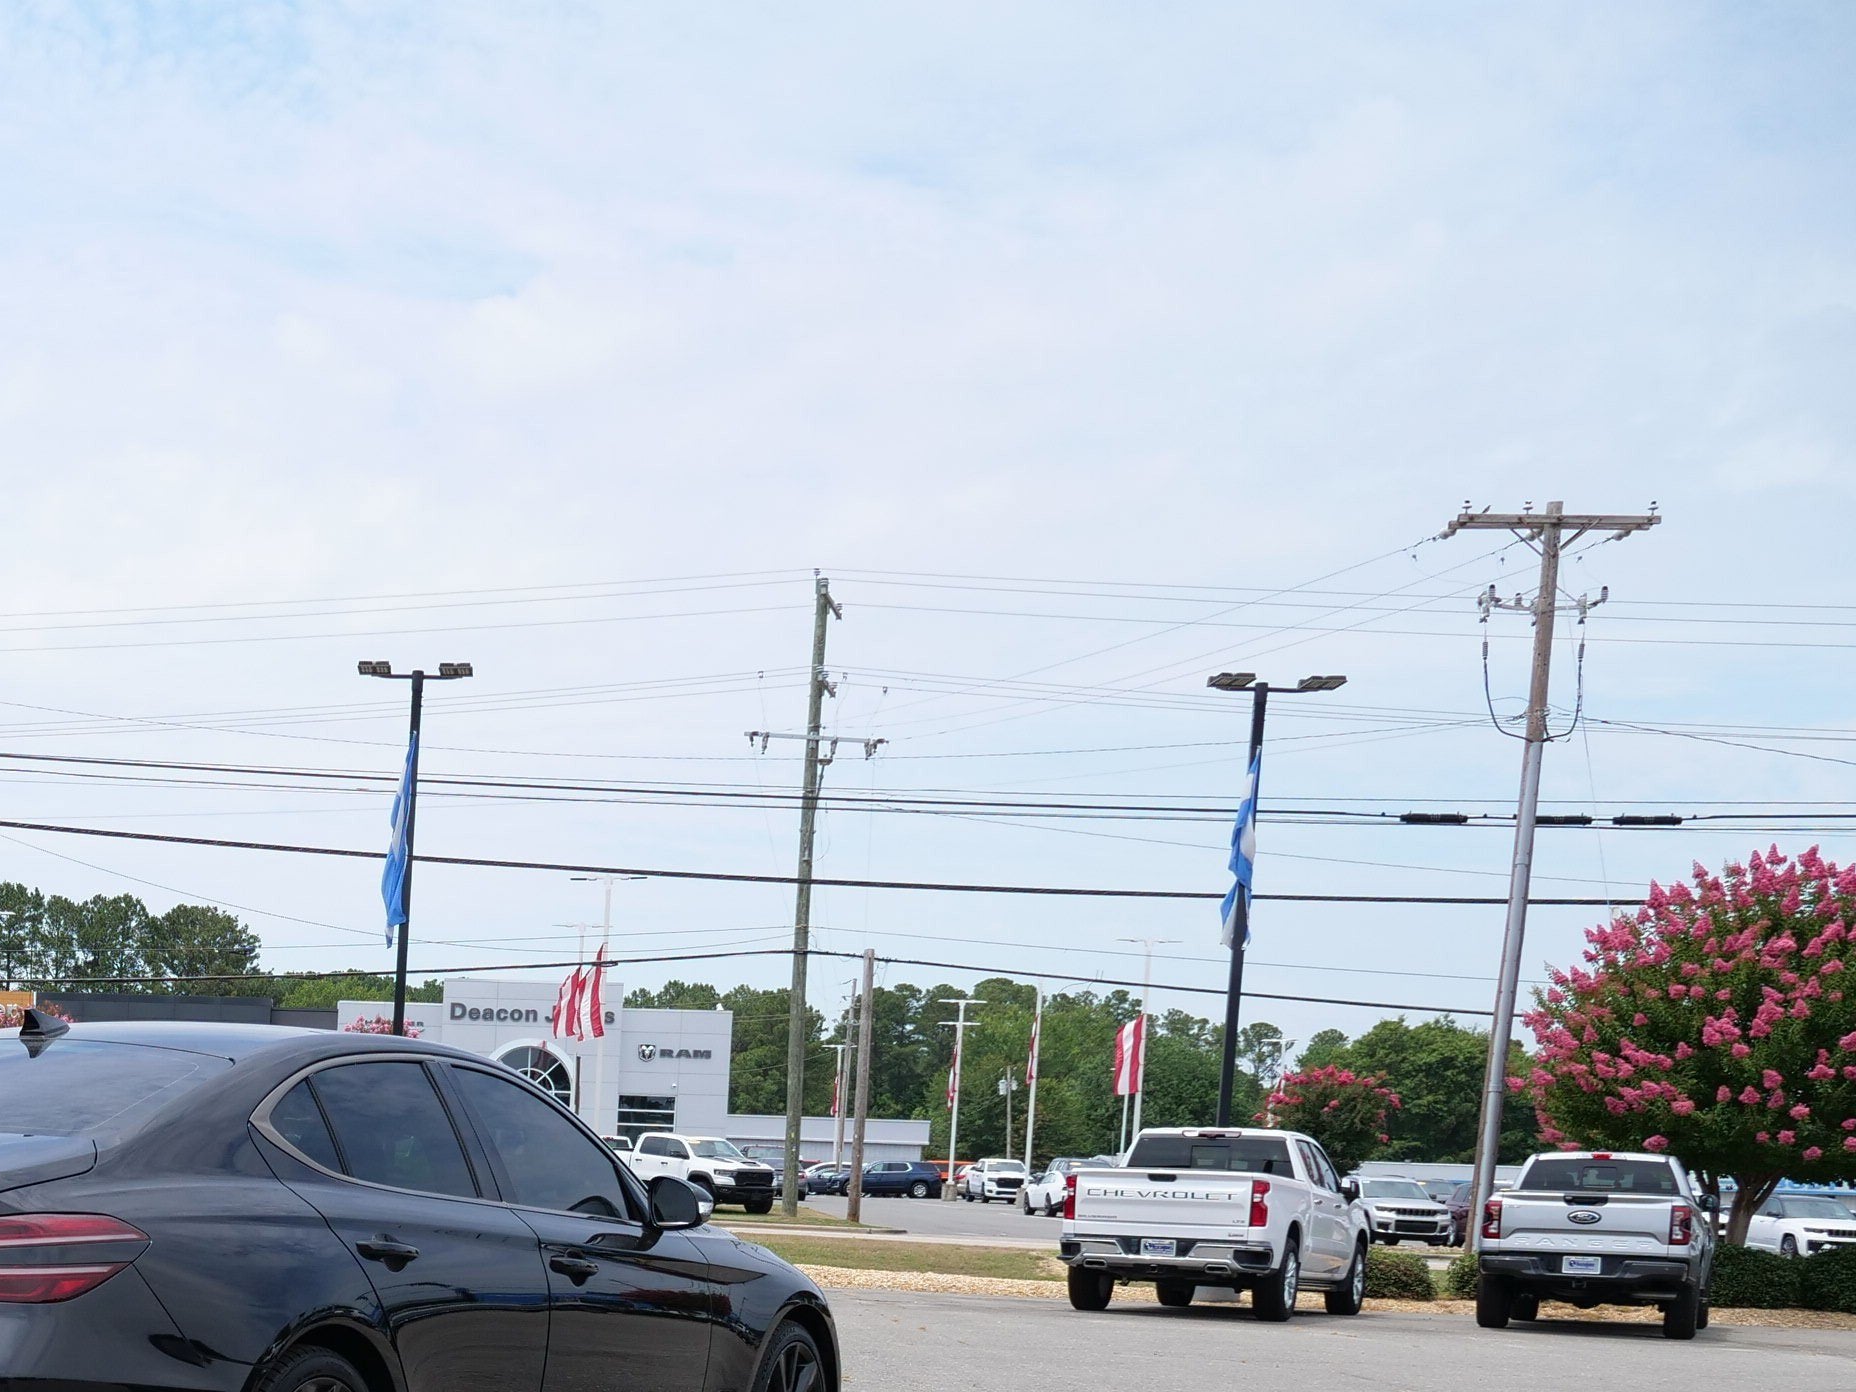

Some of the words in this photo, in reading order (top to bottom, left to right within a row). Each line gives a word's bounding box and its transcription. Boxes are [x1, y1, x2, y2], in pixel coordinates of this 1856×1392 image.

[450, 1002, 538, 1023] Deacon
[659, 1048, 712, 1060] RAM
[1087, 1188, 1238, 1201] CHEVROLET
[1513, 1235, 1654, 1250] RANGER
